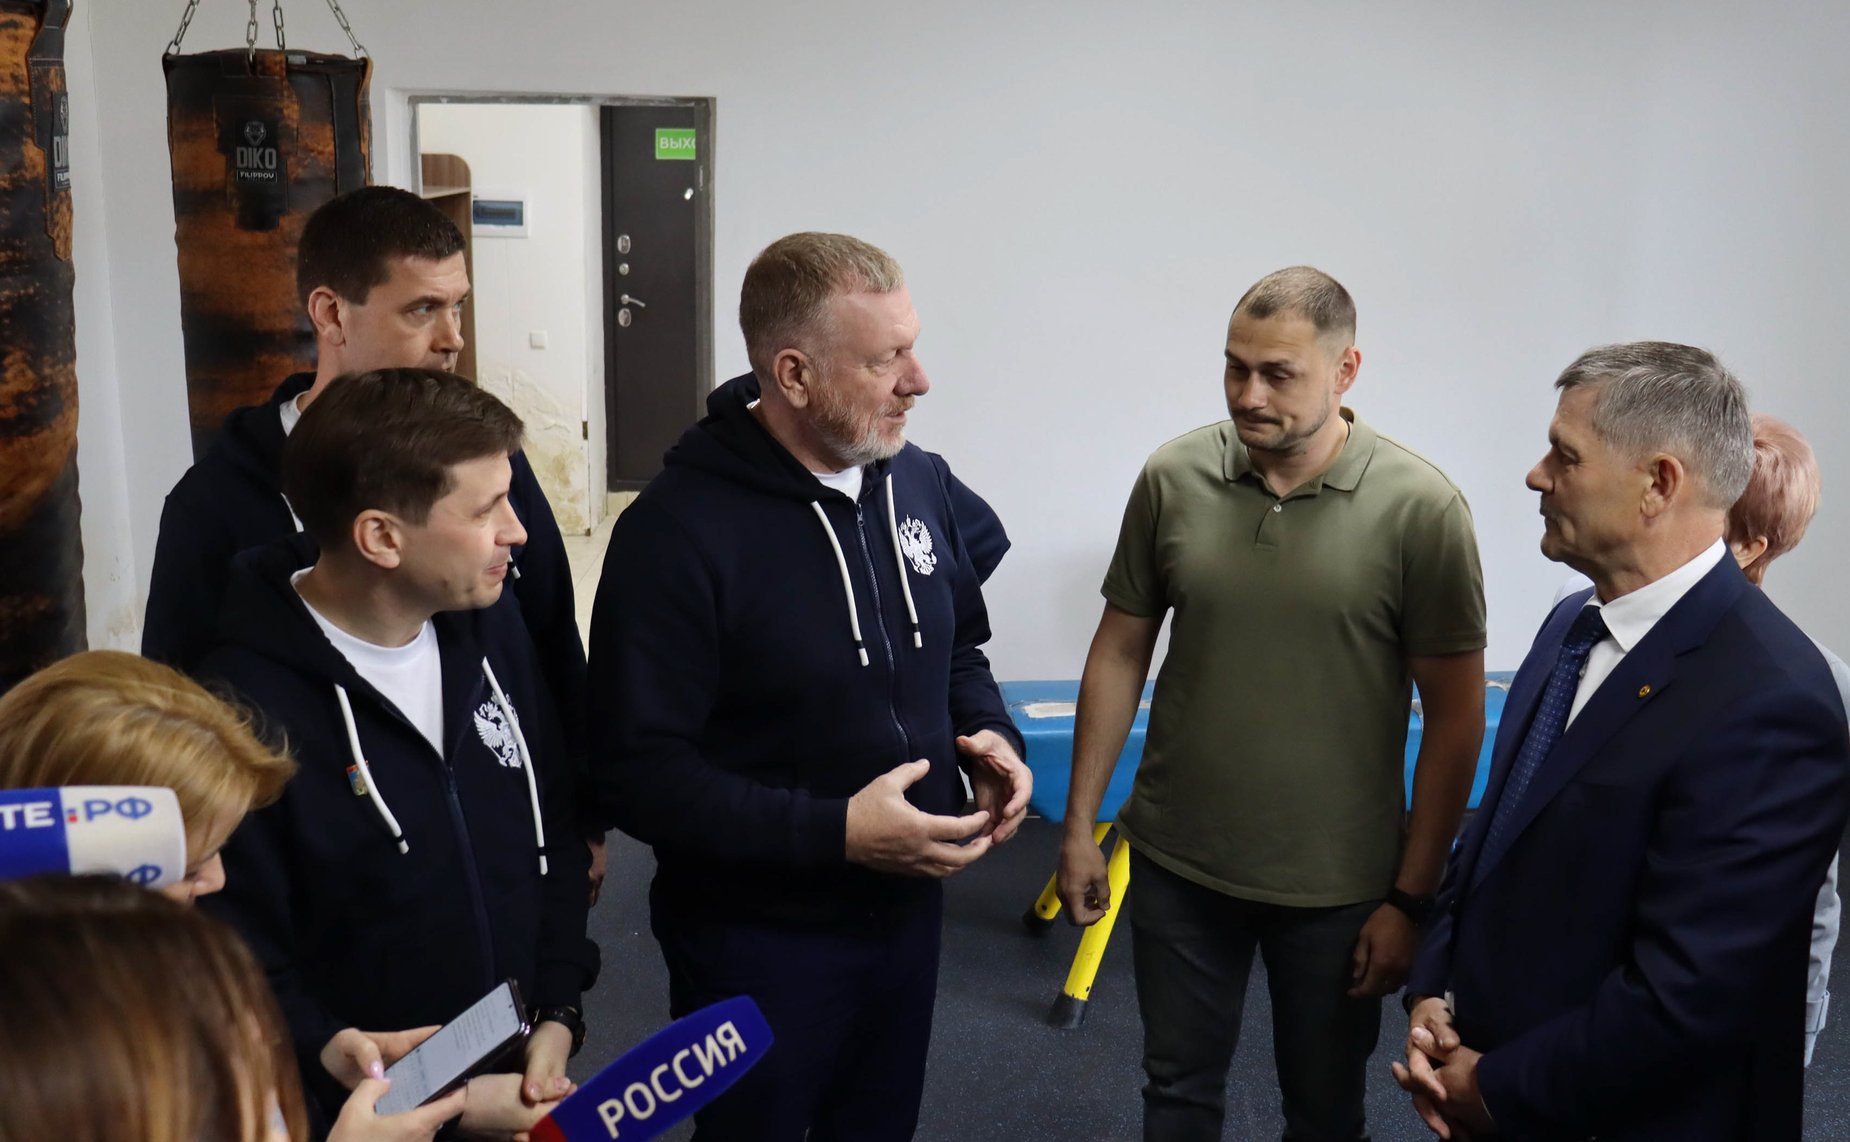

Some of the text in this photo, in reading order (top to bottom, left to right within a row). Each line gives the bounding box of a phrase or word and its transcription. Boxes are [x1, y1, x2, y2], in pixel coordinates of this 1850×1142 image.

[236, 146, 277, 169] DIKO
[240, 171, 274, 179] FILIPPOV
[597, 1020, 747, 1139] РОССИЯ
